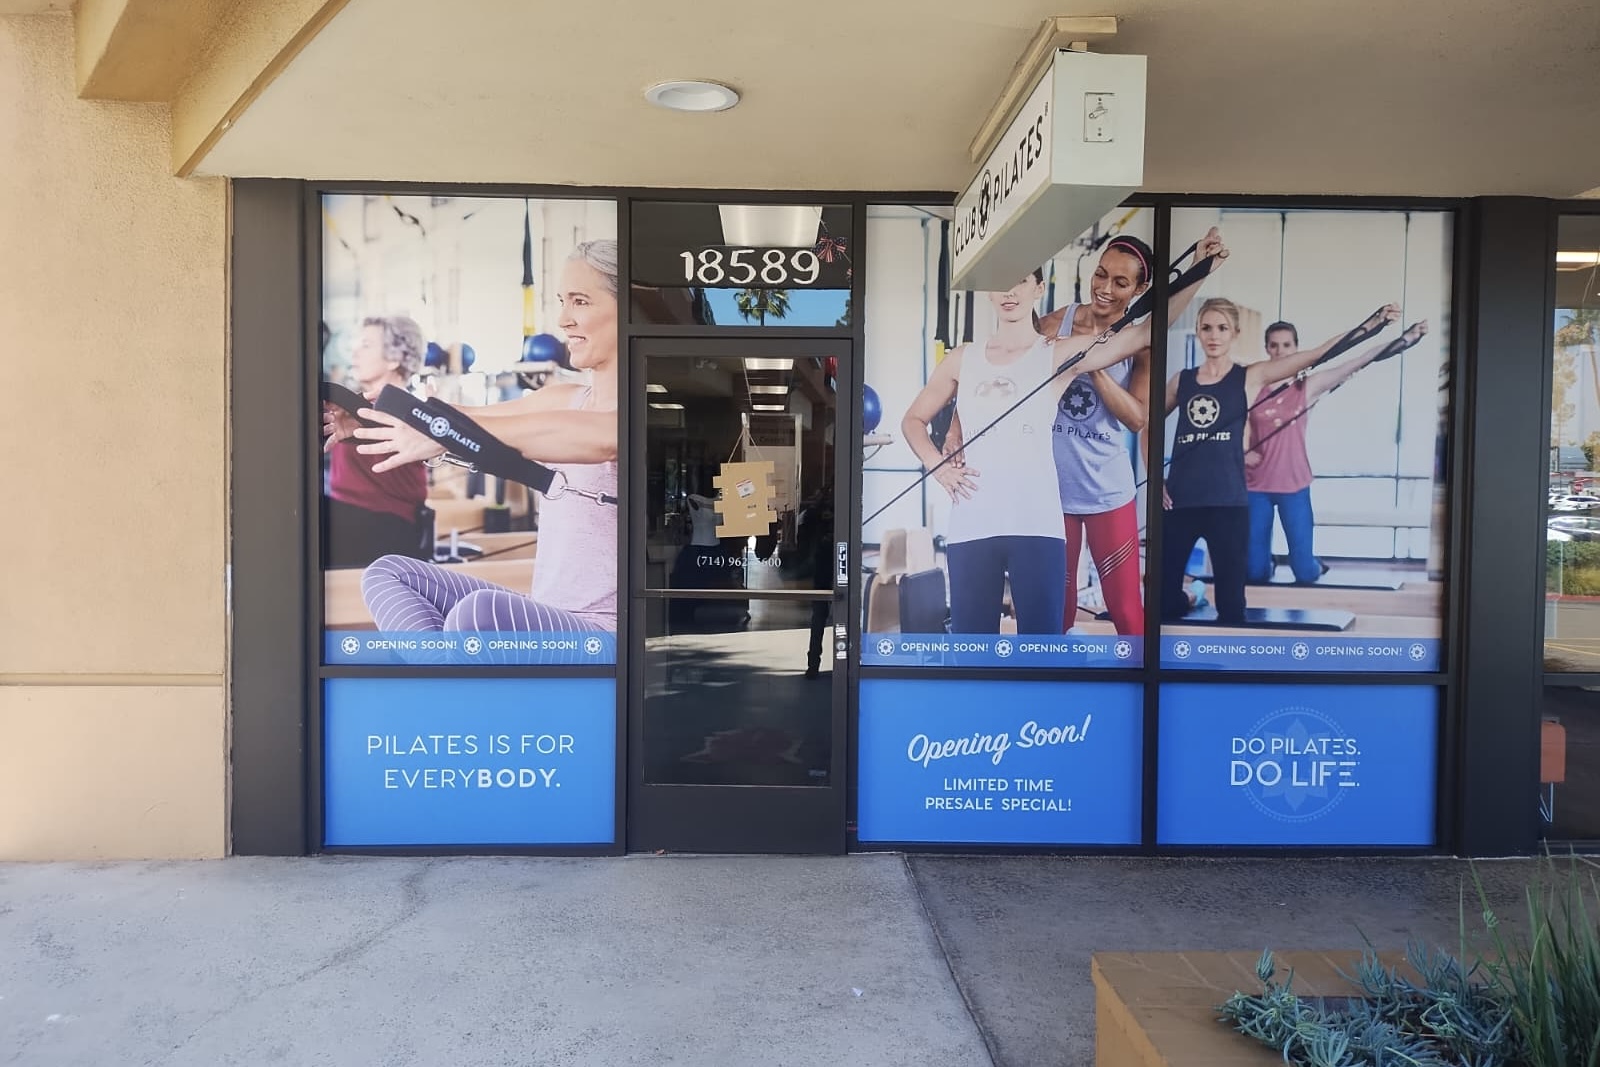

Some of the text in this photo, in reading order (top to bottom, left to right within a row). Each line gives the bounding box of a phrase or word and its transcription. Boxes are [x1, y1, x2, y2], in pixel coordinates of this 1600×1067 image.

[955, 115, 1043, 257] CLUB PILATES
[680, 249, 820, 285] 18589
[412, 408, 481, 452] CLUB PILATES
[696, 555, 725, 567] (714)
[838, 546, 846, 576] PULL
[366, 640, 578, 650] OPENING SOON! OPENING SOON!
[901, 643, 1108, 654] OPENING SOON! OPENING SOON!
[1198, 645, 1402, 656] OPENING SOON! OPENING SOON!
[367, 734, 574, 755] PILATES IS FOR
[907, 714, 1092, 769] Opening Soon!
[1232, 737, 1361, 755] DO PILATES.
[384, 768, 561, 789] EVERYBODY.
[1230, 760, 1360, 787] DO LIFE.
[944, 777, 1054, 792] LIMITED TIME
[925, 797, 1072, 812] PRESALE SPECIAL!
